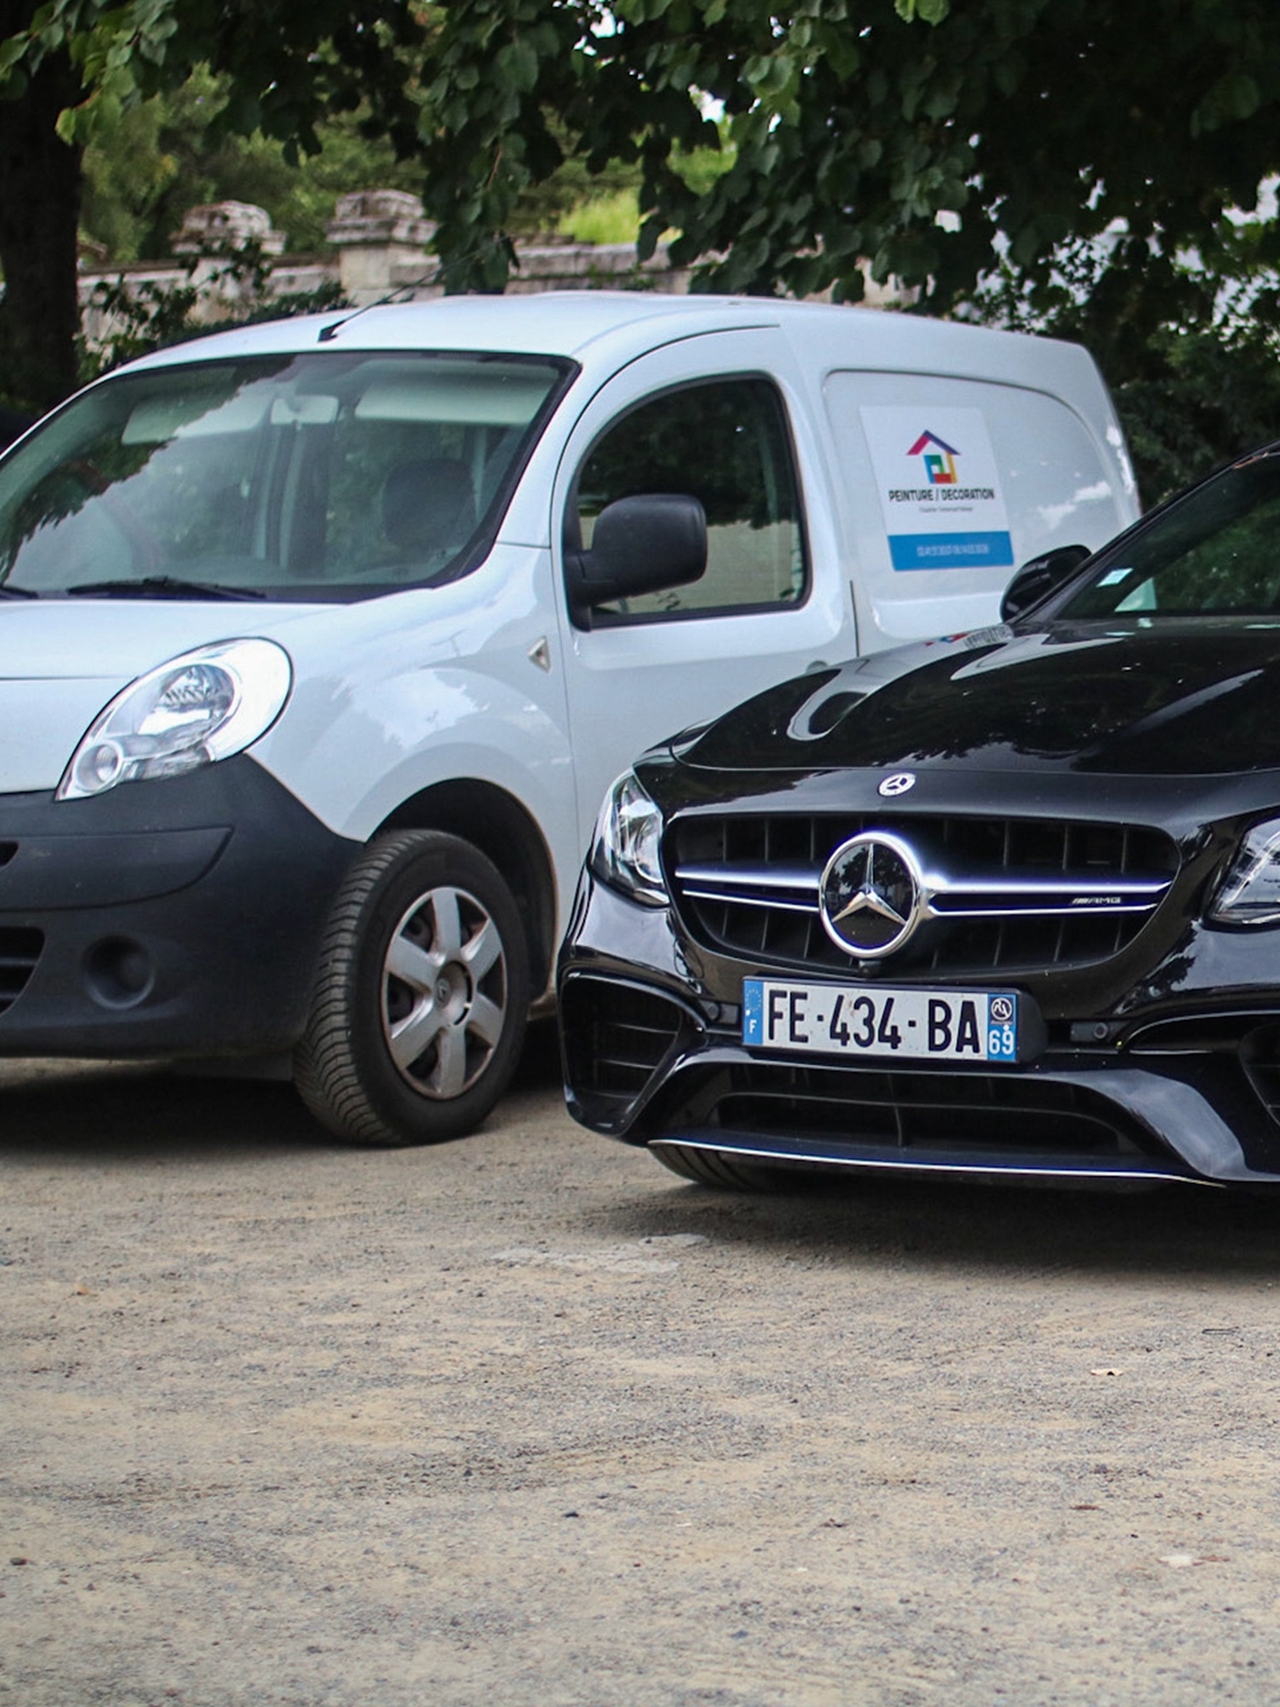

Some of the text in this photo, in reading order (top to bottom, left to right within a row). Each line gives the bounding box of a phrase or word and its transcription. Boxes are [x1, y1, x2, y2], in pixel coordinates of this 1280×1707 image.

[888, 489, 933, 501] PEINTURE
[942, 488, 994, 500] DECORATION
[750, 1019, 756, 1033] F
[989, 1029, 1014, 1054] 69
